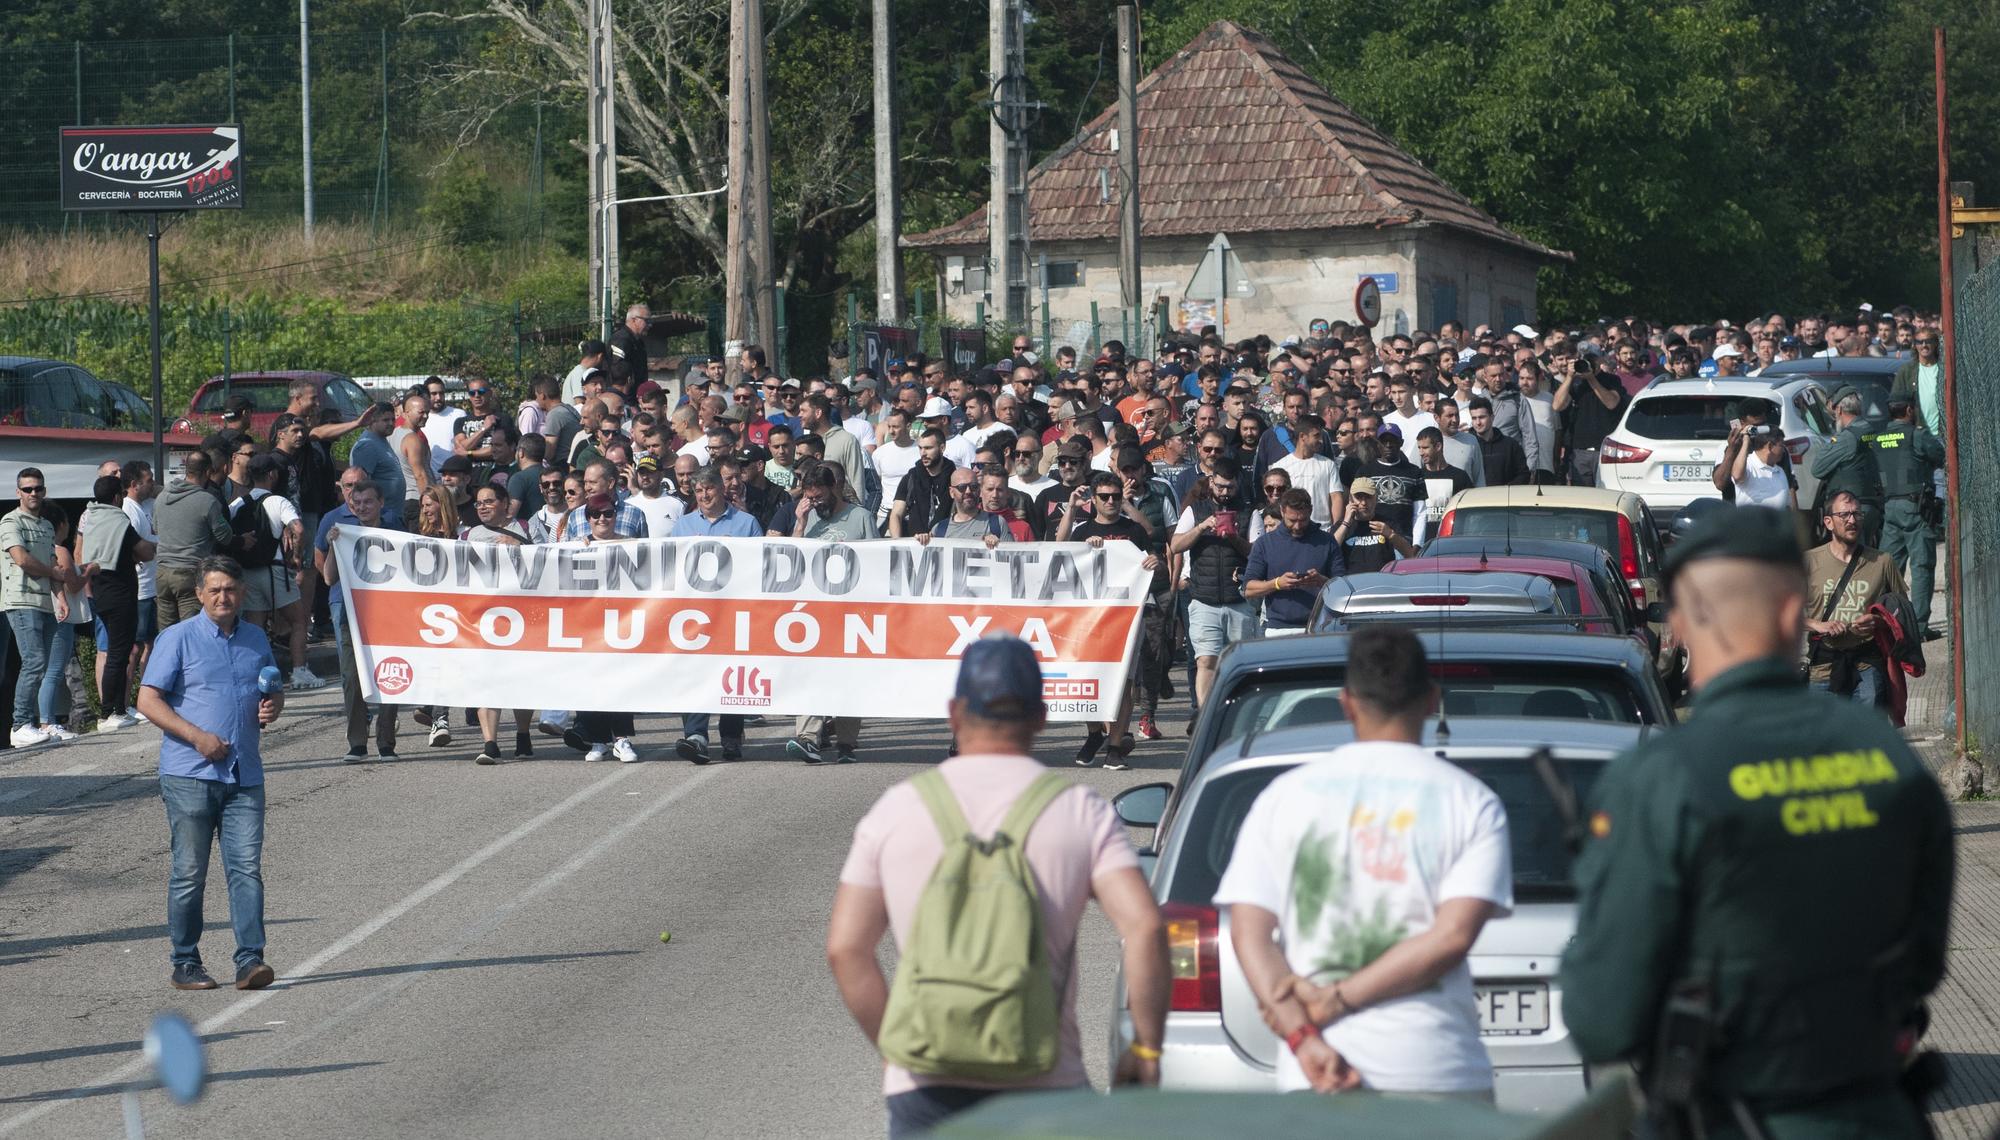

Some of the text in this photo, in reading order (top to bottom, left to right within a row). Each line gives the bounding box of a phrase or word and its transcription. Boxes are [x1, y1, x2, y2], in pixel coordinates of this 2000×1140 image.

[73, 143, 193, 180] O'angar
[79, 189, 183, 200] CERVECERÍA BOCATERÍA
[196, 184, 237, 205] RESERVA
[1876, 432, 1905, 442] GUARDIA
[1881, 440, 1898, 448] CIVIL
[1672, 466, 1701, 478] 5788
[353, 534, 1130, 600] CONVENIO DO METAL
[419, 602, 1058, 658] SOLUCIÓN XA
[379, 662, 409, 678] UGT
[721, 665, 771, 696] CIG
[1042, 682, 1095, 696] CCOO
[721, 697, 771, 706] INDUSTRIA
[1045, 700, 1098, 713] dustria
[1729, 748, 1897, 801] GUARDIA
[1781, 790, 1880, 836] CIVIL
